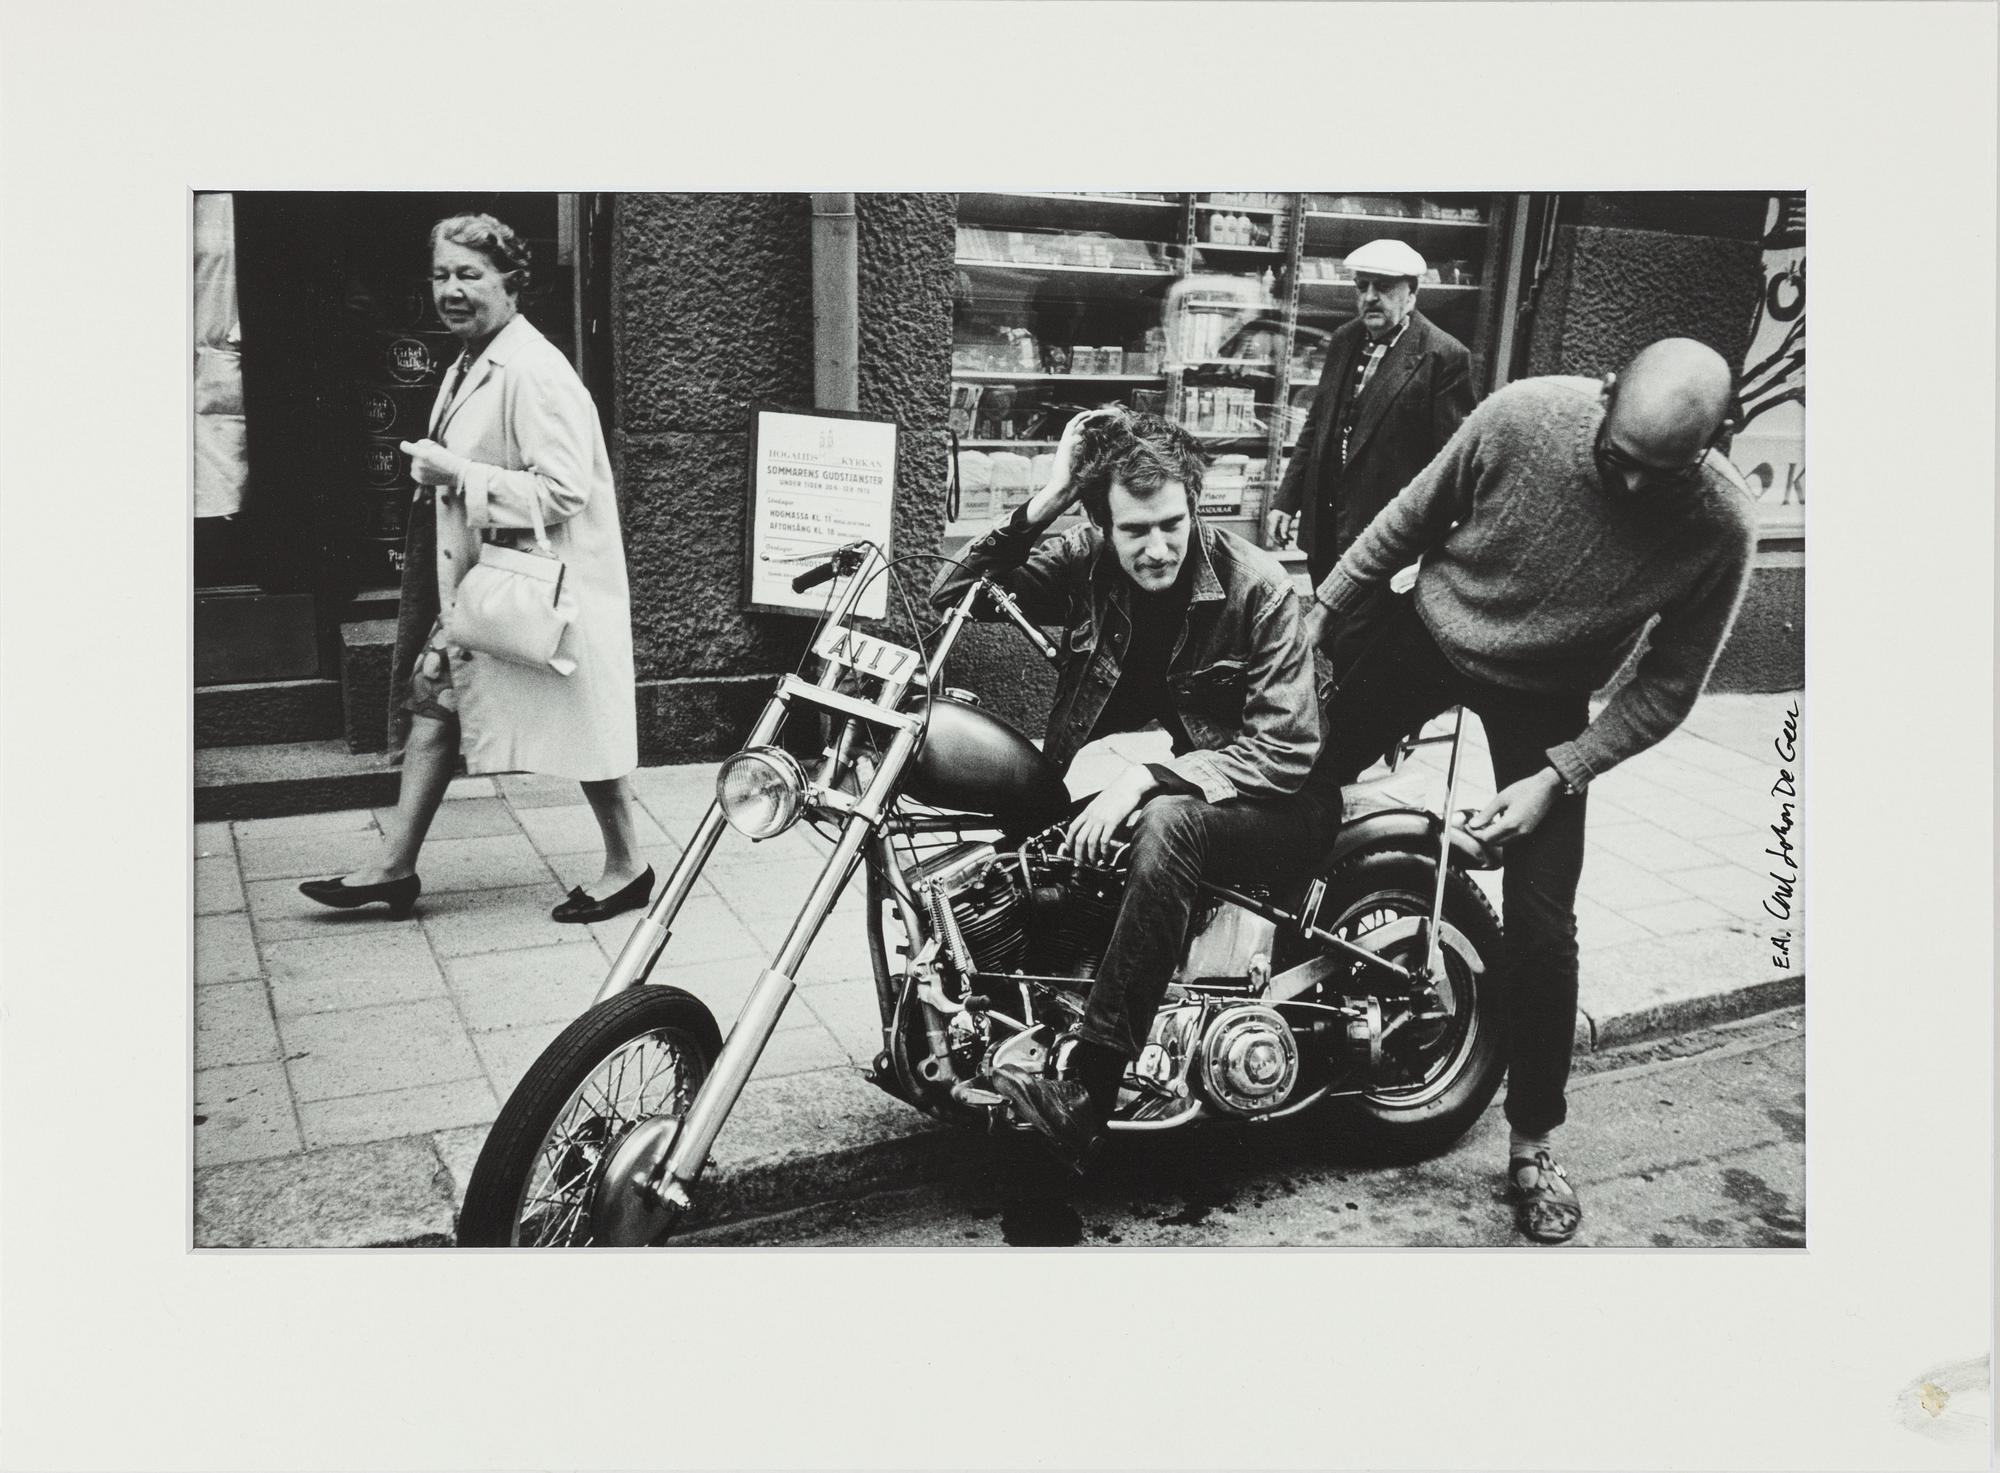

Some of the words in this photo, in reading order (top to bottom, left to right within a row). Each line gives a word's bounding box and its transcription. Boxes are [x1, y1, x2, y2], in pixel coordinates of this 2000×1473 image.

[766, 465, 820, 479] SOMMARENS
[825, 515, 832, 523] 11
[828, 633, 909, 675] A117
[1771, 768, 1796, 798] De
[1765, 802, 1798, 870] Johan
[1763, 871, 1797, 921] Carl
[1771, 930, 1792, 970] E.A.
